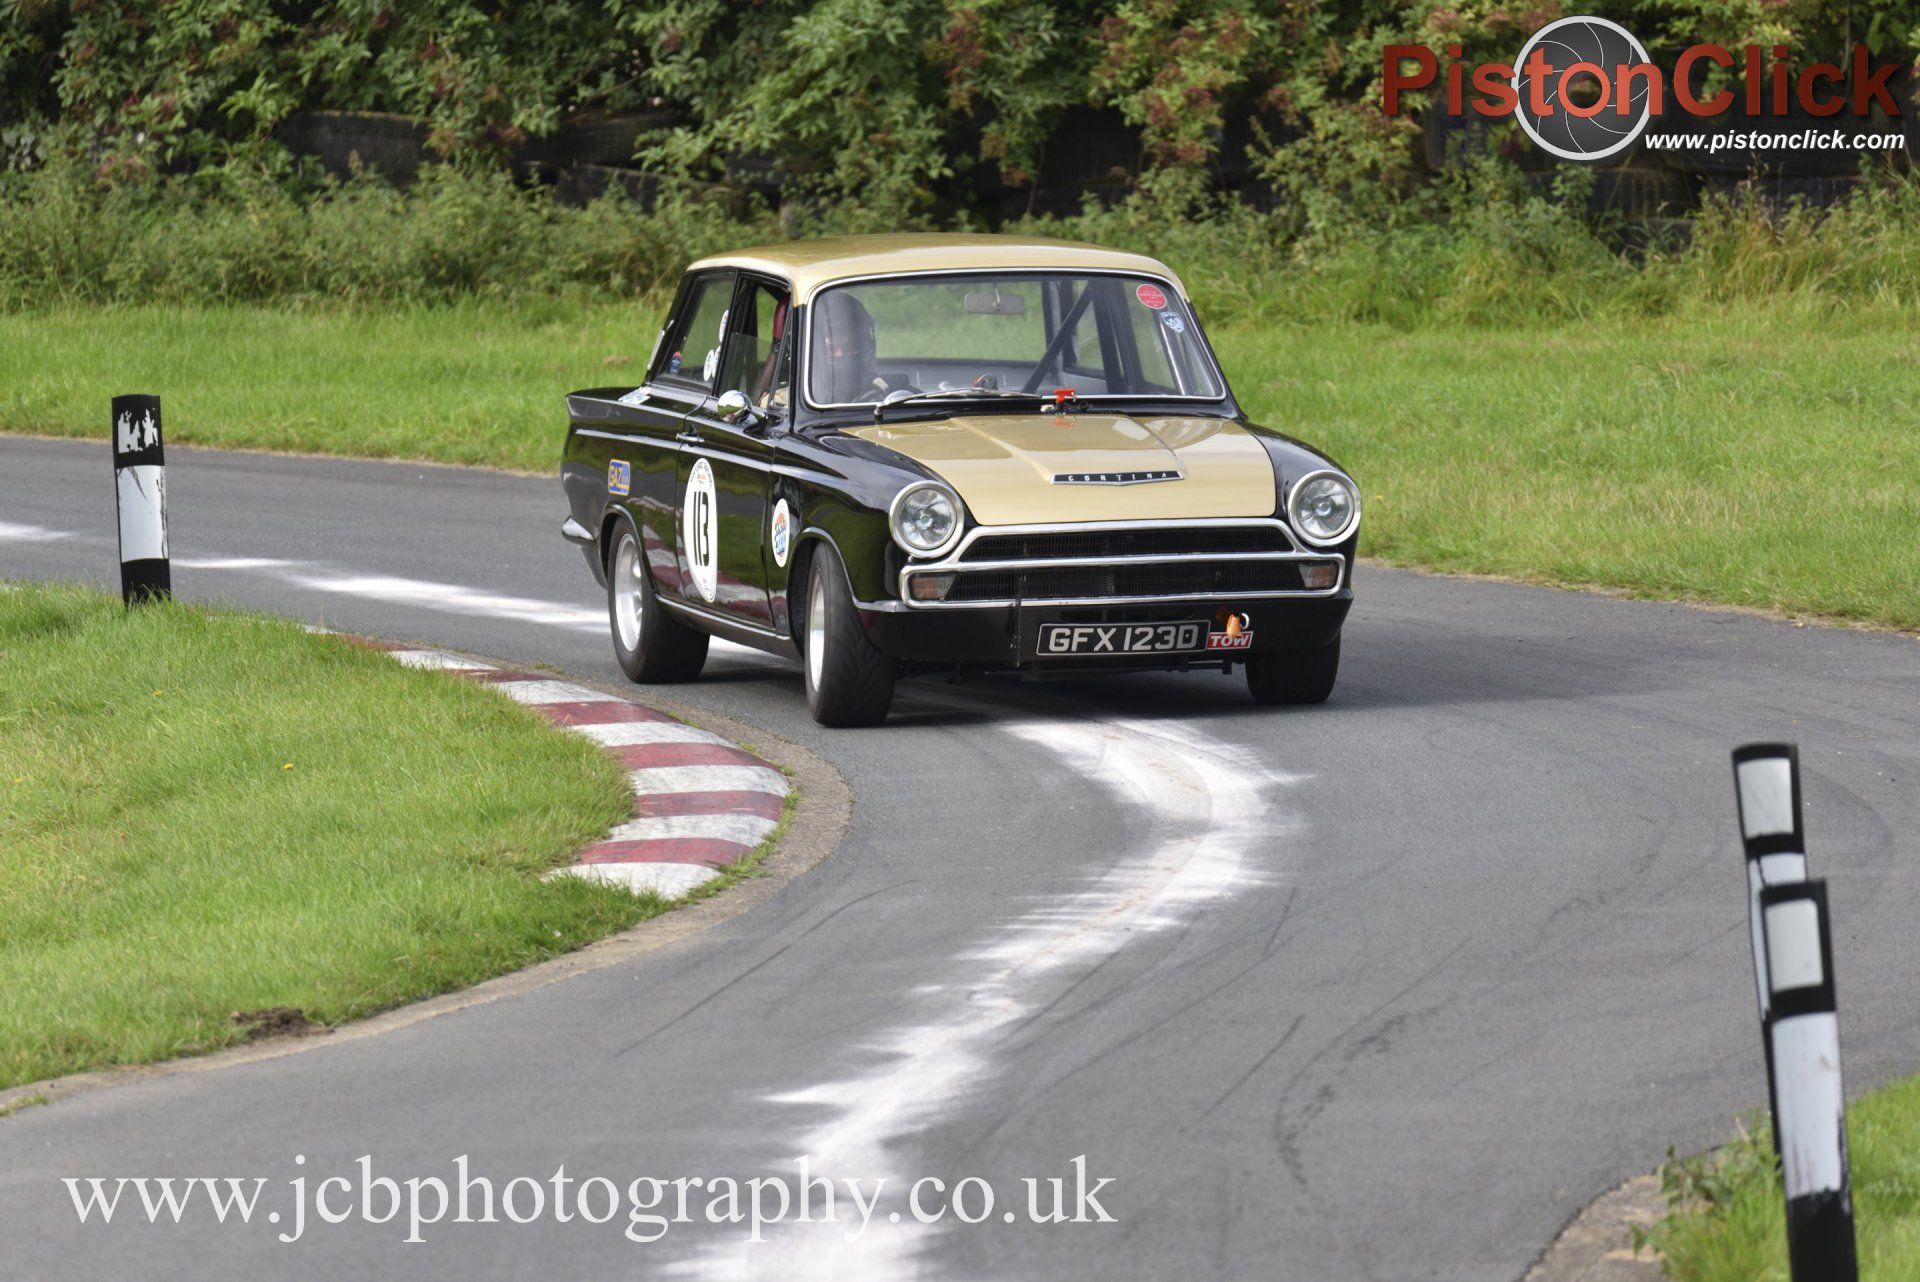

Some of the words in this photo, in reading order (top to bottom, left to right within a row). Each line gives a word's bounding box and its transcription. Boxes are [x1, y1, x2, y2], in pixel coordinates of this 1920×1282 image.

[1068, 473, 1167, 481] CORTINA
[693, 491, 710, 567] 113
[1049, 627, 1117, 652] GFX
[1123, 624, 1199, 651] 123D
[1211, 634, 1250, 647] TOW
